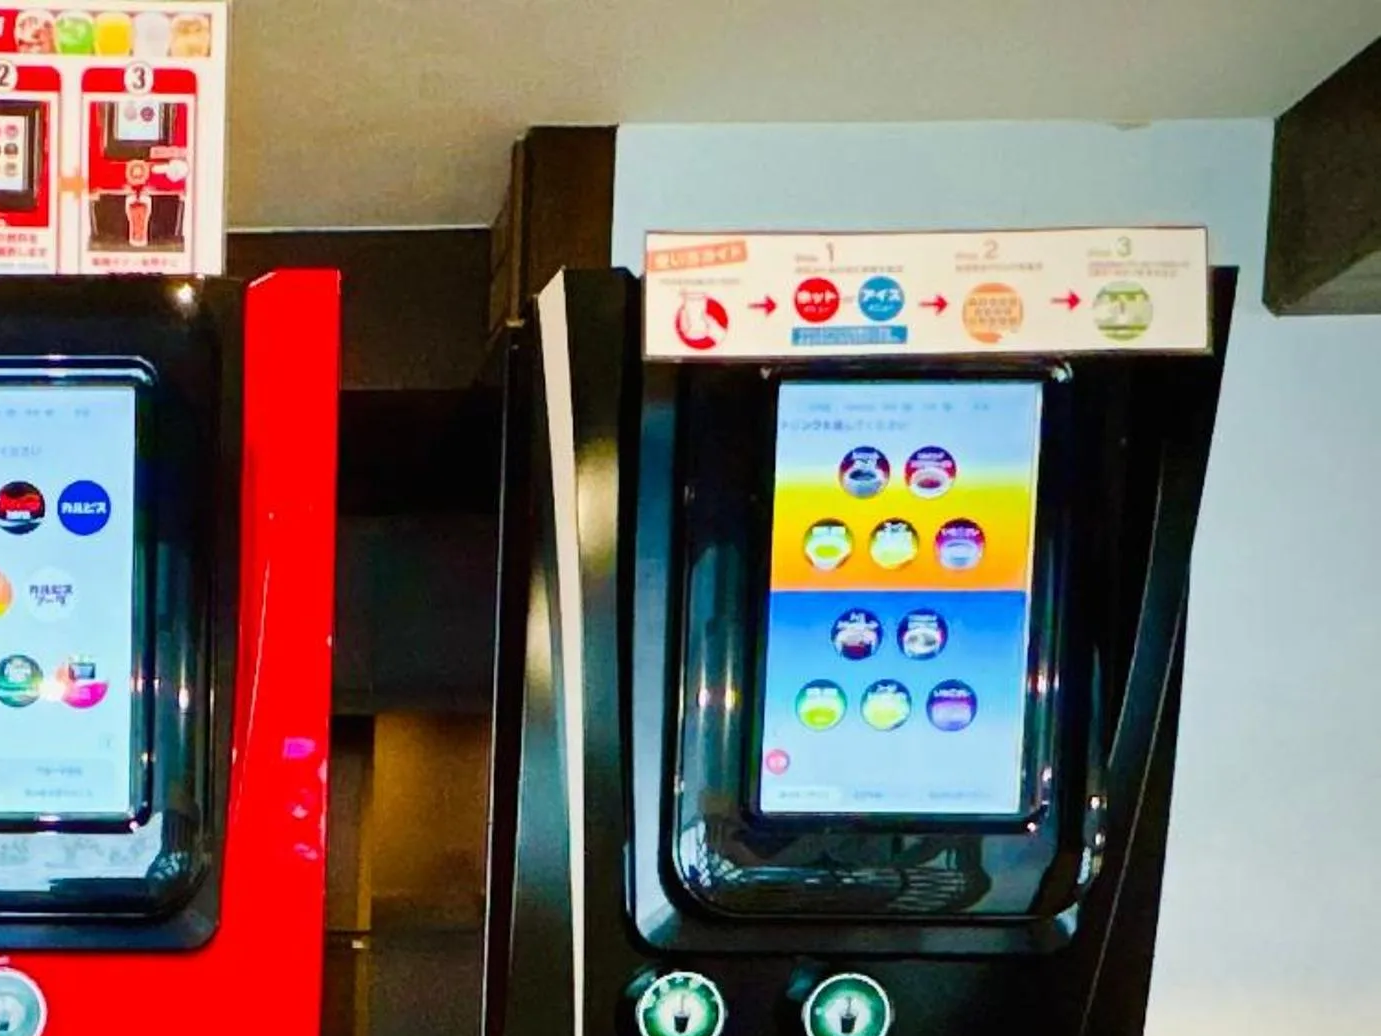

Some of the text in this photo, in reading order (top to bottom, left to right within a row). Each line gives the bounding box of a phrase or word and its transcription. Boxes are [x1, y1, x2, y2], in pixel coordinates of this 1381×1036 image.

[132, 68, 146, 88] 3
[826, 241, 834, 262] 1
[983, 239, 999, 259] 2
[1116, 236, 1132, 257] 3
[862, 288, 900, 302] アイス
[61, 502, 107, 515] カルピス
